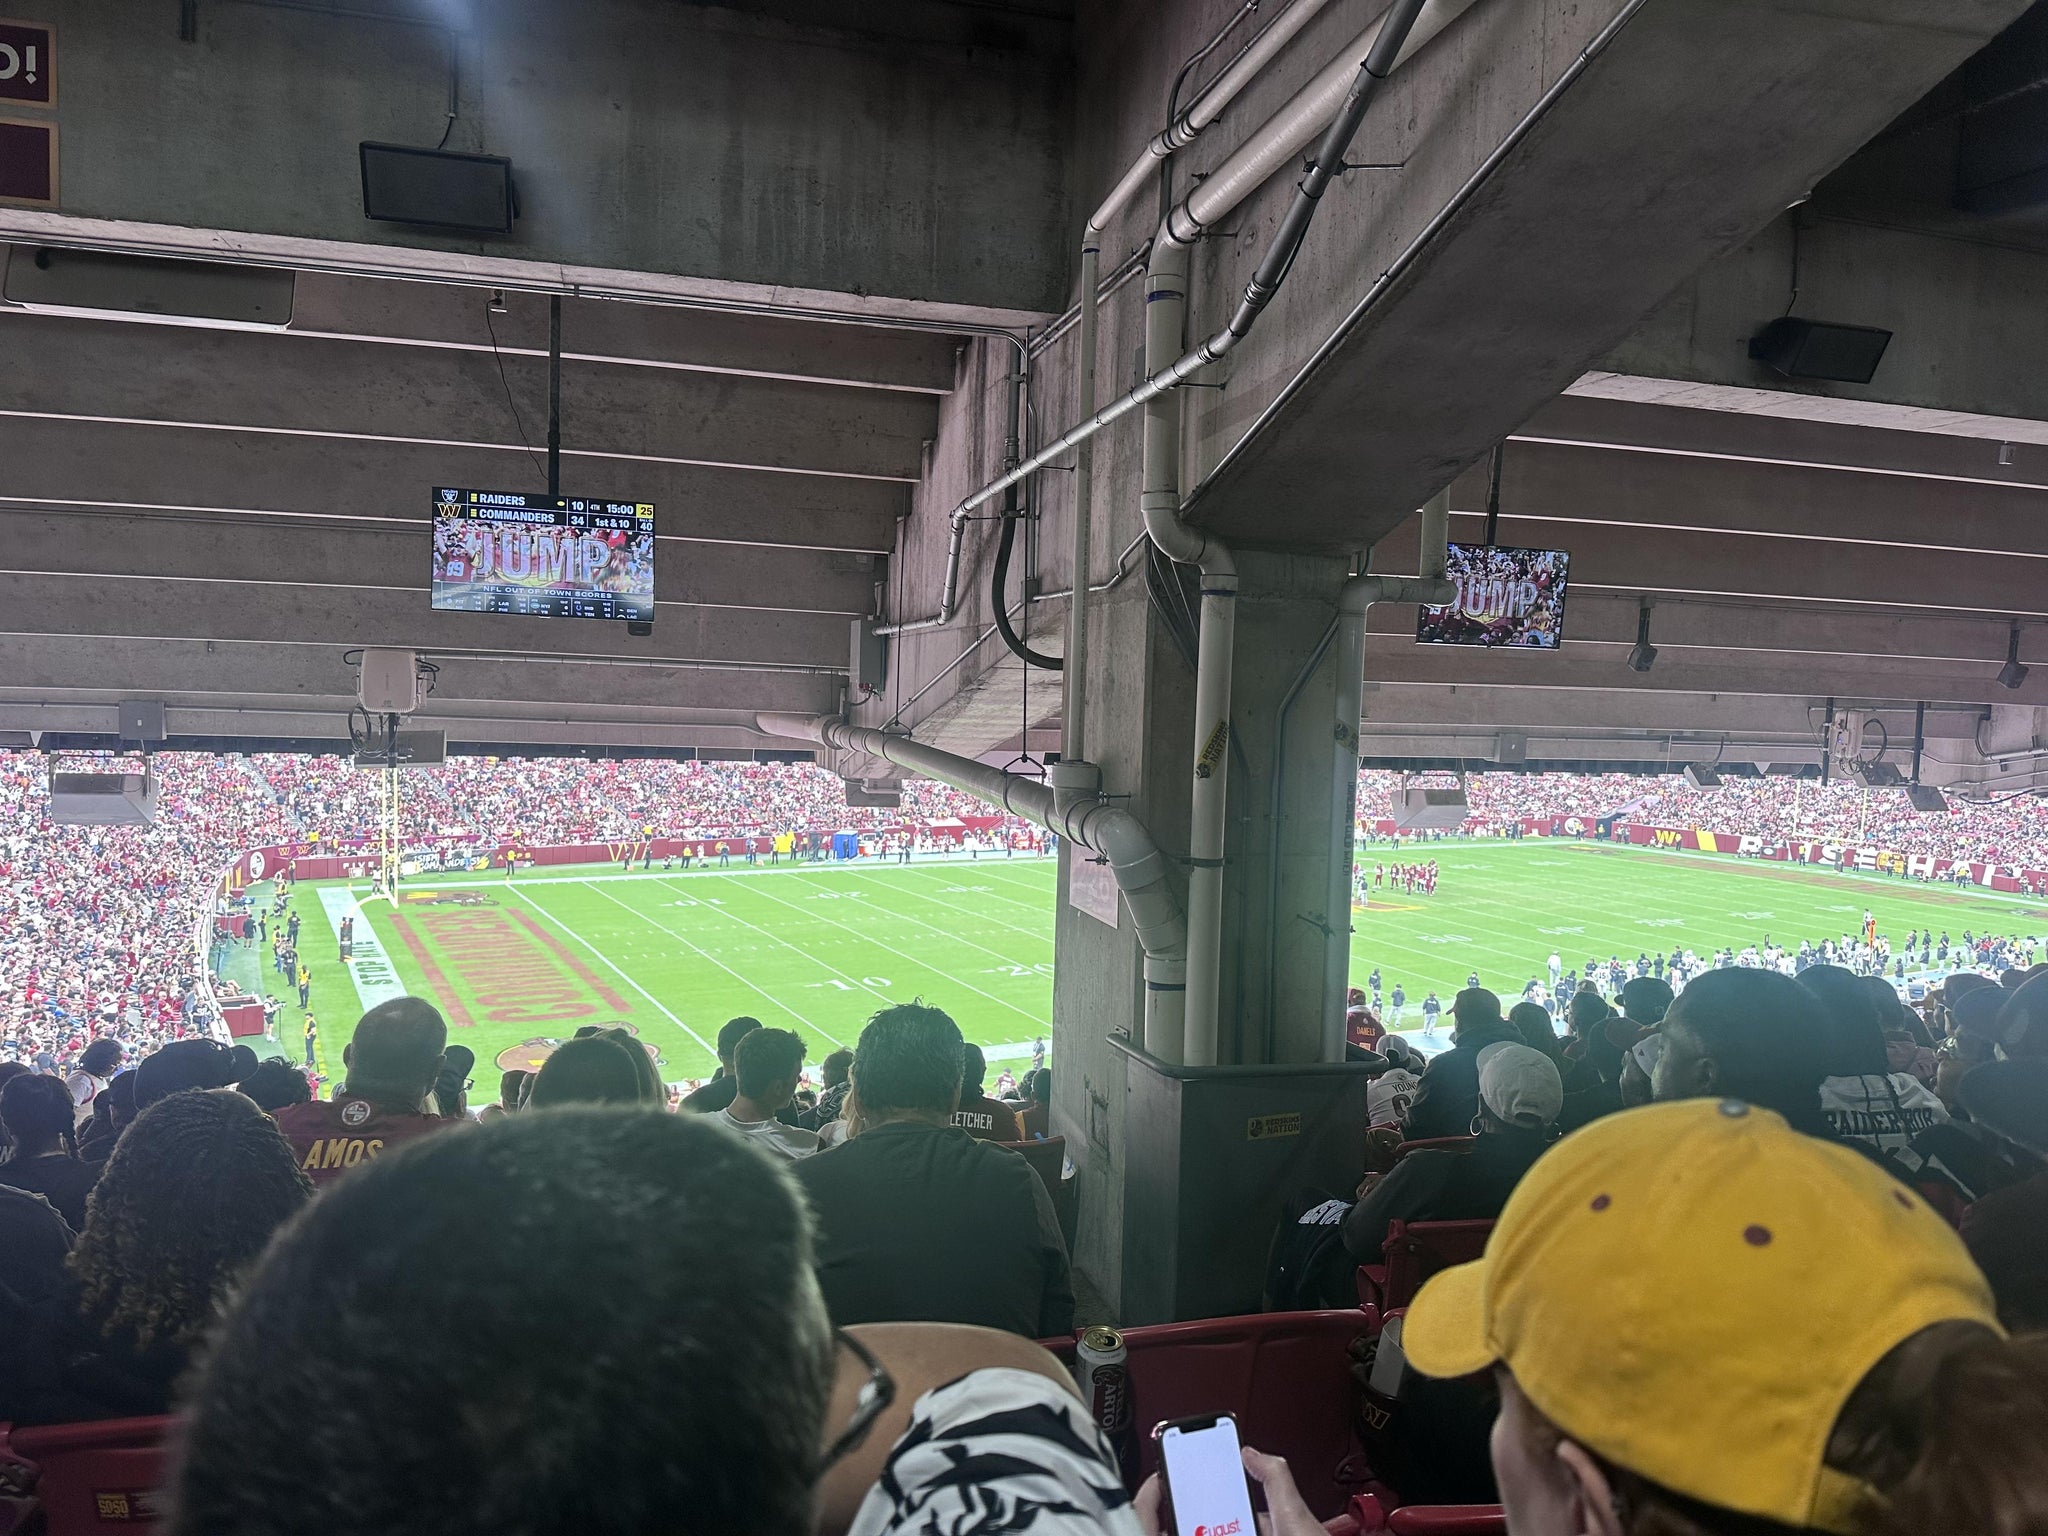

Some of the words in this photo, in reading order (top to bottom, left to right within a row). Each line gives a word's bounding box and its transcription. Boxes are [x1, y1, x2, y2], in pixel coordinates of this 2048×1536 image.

[480, 493, 526, 506] RAIDERS
[571, 501, 584, 511] 10
[479, 508, 555, 523] COMMANDERS
[606, 504, 634, 515] 15:00
[640, 507, 653, 515] 25
[571, 515, 584, 525] 34
[595, 518, 609, 527] 1st
[610, 518, 618, 528] &
[619, 519, 630, 528] 10
[640, 522, 653, 531] 40
[473, 529, 612, 585] JUMP
[483, 585, 502, 593] NFL
[544, 589, 572, 597] TOWN
[575, 591, 612, 599] SCORES
[415, 909, 600, 1023] COMMANDERS
[998, 963, 1055, 977] 20
[355, 960, 394, 986] STOP
[824, 976, 892, 991] 10
[1266, 1123, 1300, 1135] NATION
[302, 1137, 384, 1170] AMOS
